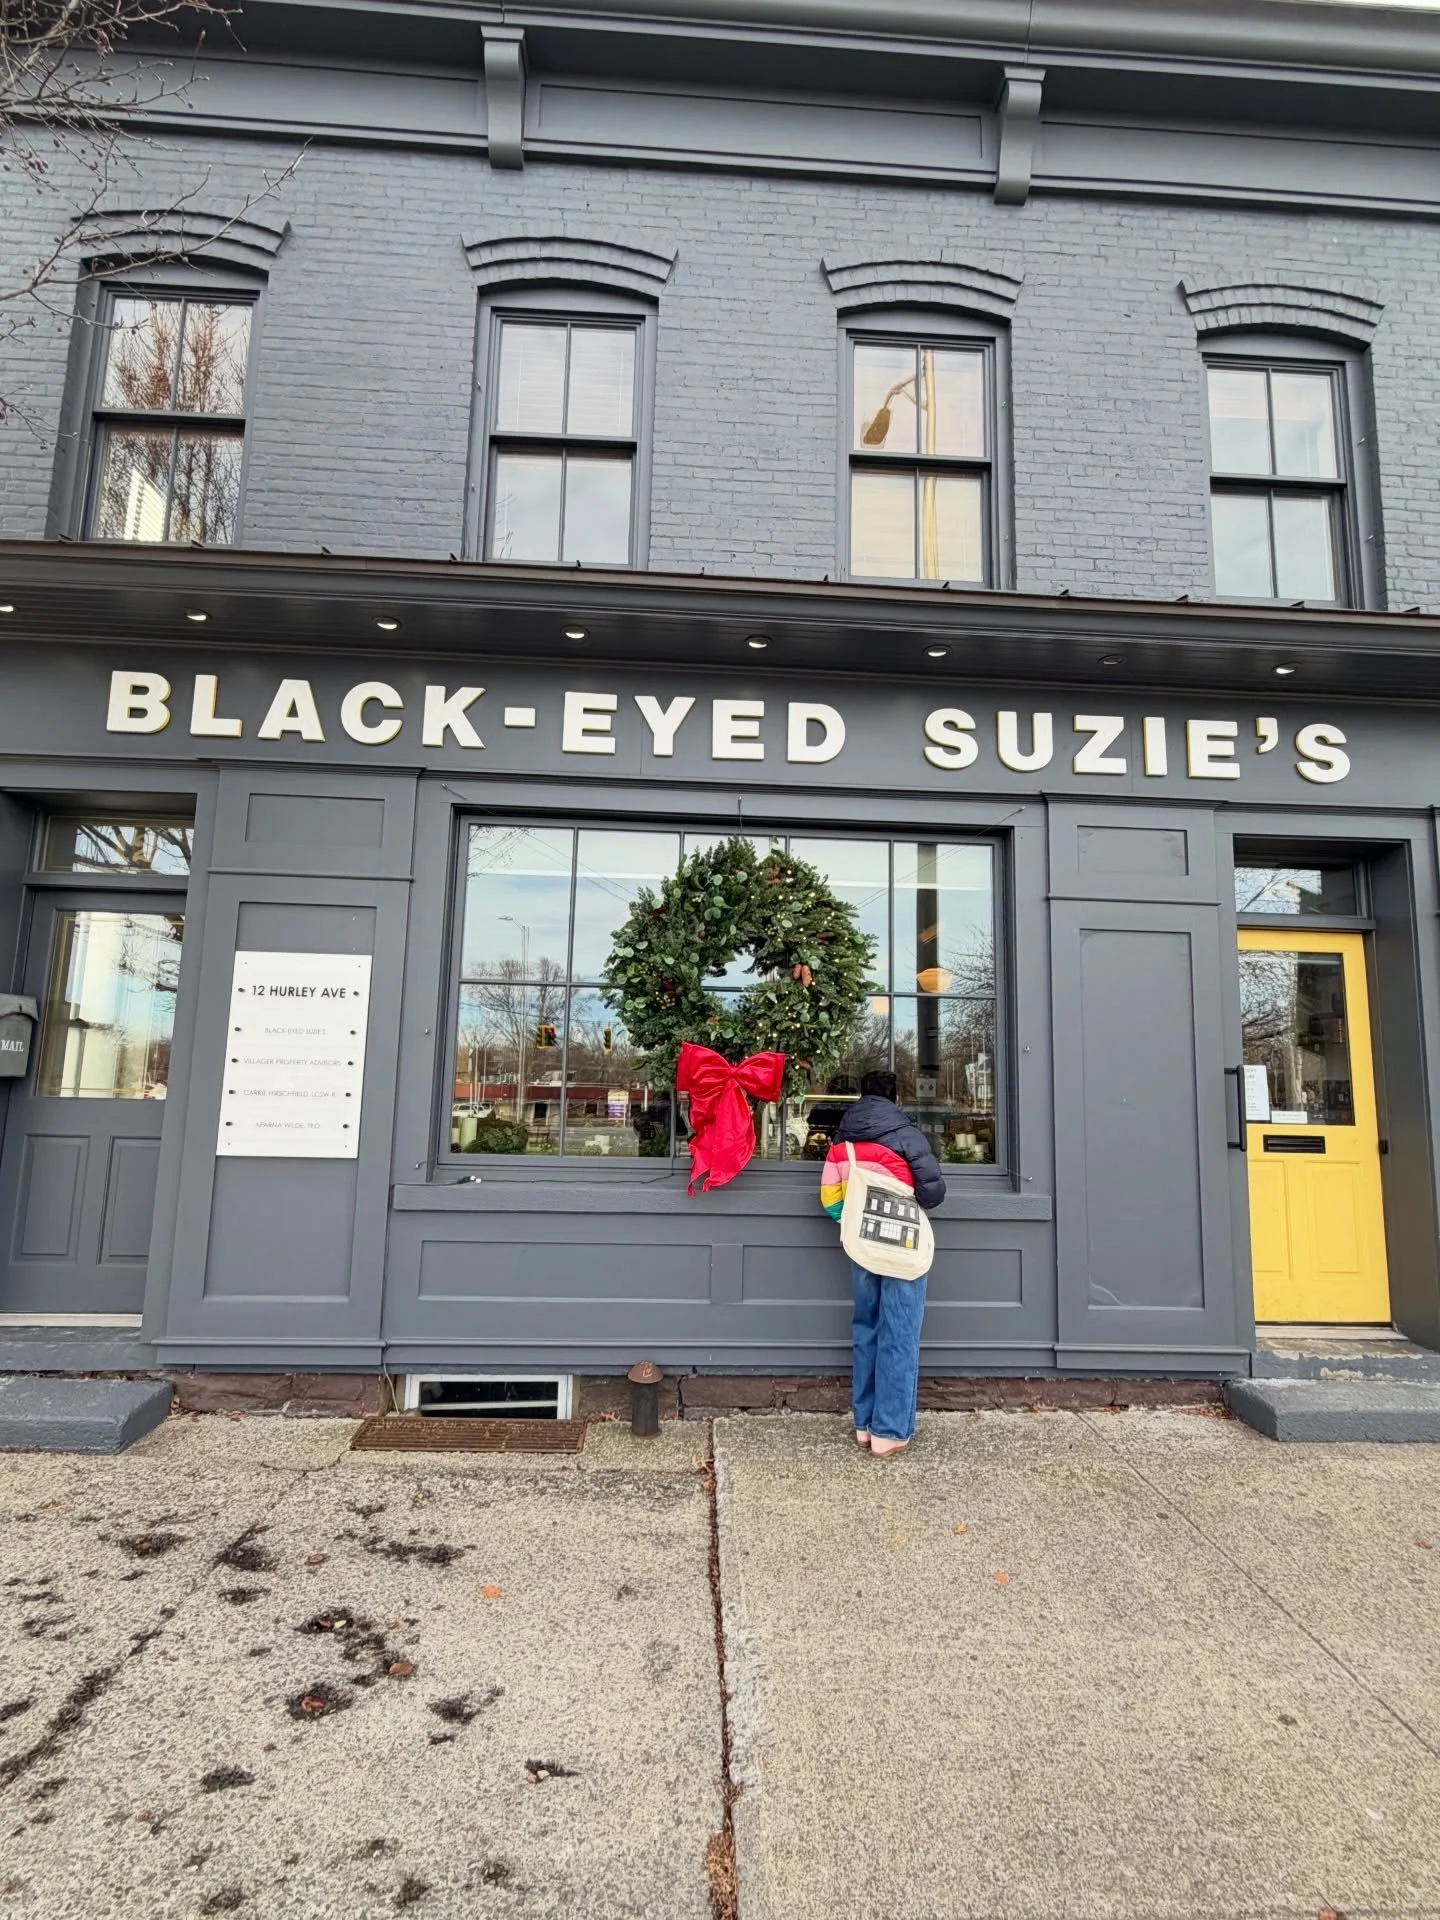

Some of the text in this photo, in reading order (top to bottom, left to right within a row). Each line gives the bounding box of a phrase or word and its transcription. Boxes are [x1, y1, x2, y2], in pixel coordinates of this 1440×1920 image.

[106, 670, 1351, 784] BLACK-EYED SUZIE'S
[252, 985, 347, 999] 12 HURLEY AVE
[1, 1039, 25, 1052] MAIL
[276, 1058, 308, 1066] PROPERTY
